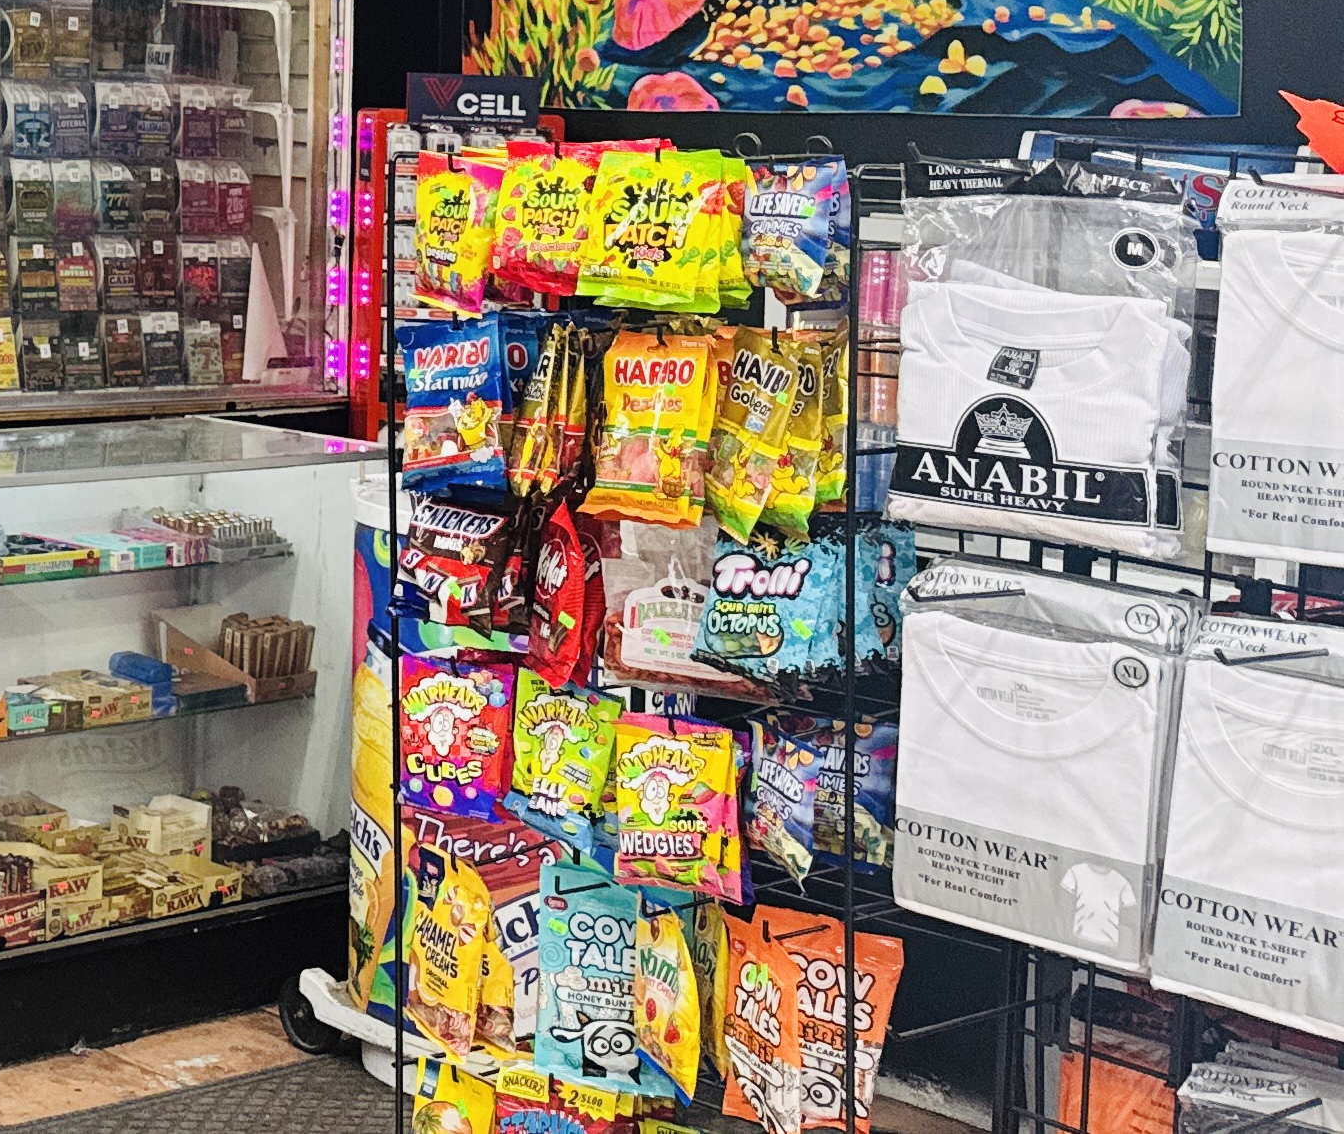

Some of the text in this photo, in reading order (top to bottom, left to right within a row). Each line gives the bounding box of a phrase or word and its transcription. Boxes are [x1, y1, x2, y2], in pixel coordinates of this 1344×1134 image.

[929, 177, 1003, 191] HEAVY THERMAL
[528, 193, 577, 209] SOUR
[612, 198, 689, 223] SOUR
[1231, 201, 1309, 211] Round Neck
[523, 208, 579, 228] PATCH
[751, 221, 801, 236] GUMMIES
[605, 224, 687, 248] PATCH
[633, 247, 663, 260] Kids
[414, 337, 489, 369] HARIBO
[413, 369, 487, 391] Starmix
[614, 359, 694, 385] HARIBO
[1213, 452, 1312, 476] COTTON
[941, 487, 1065, 511] SUPER HEAVY
[1257, 492, 1344, 508] HEAVY WEIGHT
[414, 504, 499, 536] SNICKERS
[715, 554, 809, 596] Trolli
[714, 601, 776, 614] SOUR BRITE
[709, 614, 781, 635] OCTOPUS
[1194, 634, 1266, 654] Round Neck
[1122, 665, 1142, 680] XL
[402, 682, 487, 712] WARHEADS
[518, 701, 597, 731] WARHEADS
[407, 754, 482, 785] CUBES
[620, 746, 705, 776] WARHEADS
[669, 820, 706, 833] SOUR
[895, 818, 978, 851] COTTON
[415, 813, 529, 867] There's
[620, 831, 693, 855] WEDGIES
[918, 847, 1020, 880] ROUND NECK T-SHIRT
[932, 861, 1005, 886] HEAVY WEIGHT
[49, 878, 91, 898] RAW
[167, 891, 199, 913] RAW
[1161, 889, 1257, 927] COTTON
[416, 913, 457, 960] CARAMEL
[1186, 921, 1306, 958] ROUND NECK T-SHIRT
[1201, 936, 1287, 964] HEAVY WEIGHT
[425, 948, 458, 979] CREAMS
[568, 991, 627, 1008] HONEY BUN
[736, 985, 780, 1047] TALES
